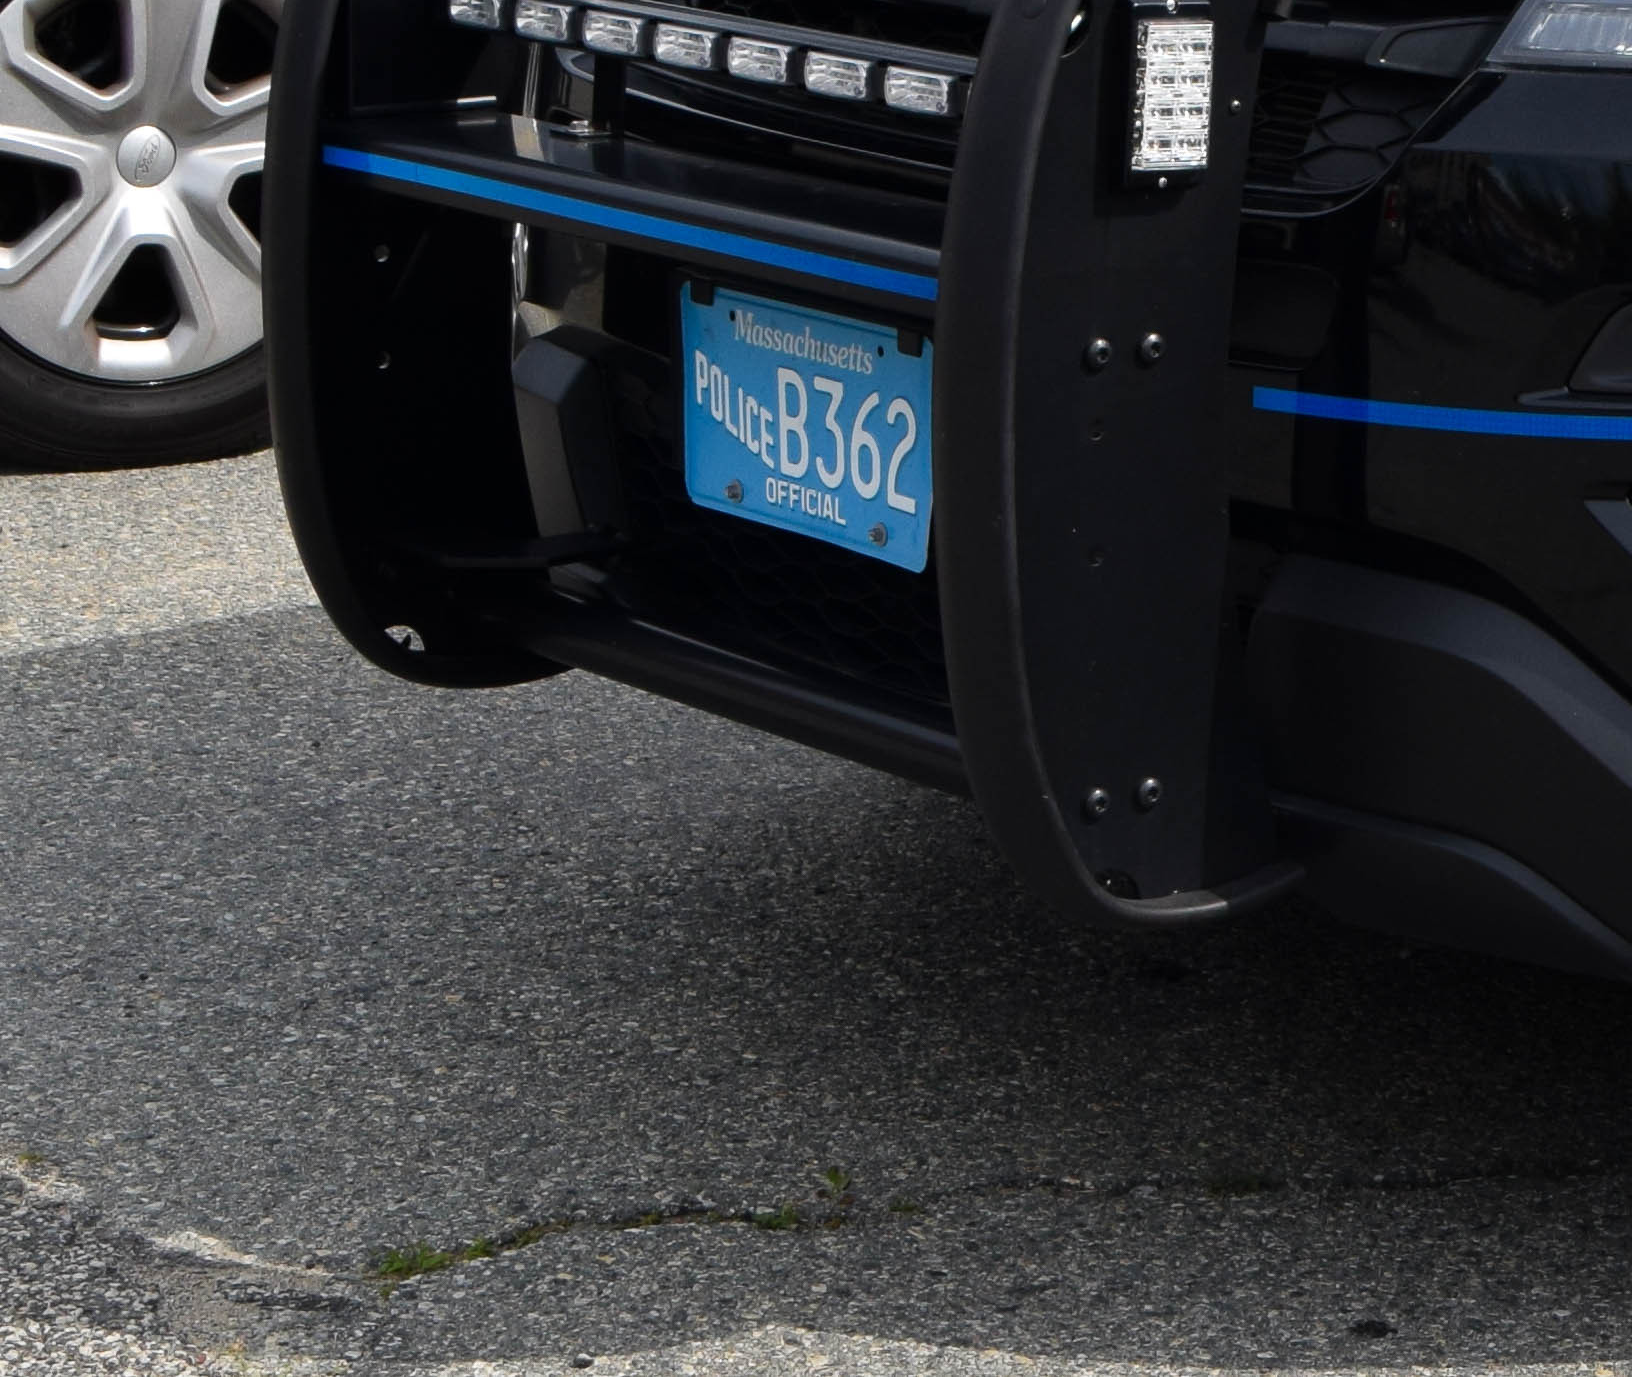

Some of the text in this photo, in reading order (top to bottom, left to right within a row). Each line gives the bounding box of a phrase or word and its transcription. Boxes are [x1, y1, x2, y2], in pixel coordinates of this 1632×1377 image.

[733, 309, 873, 374] Massachusetts
[695, 350, 917, 515] POLICE B362
[765, 477, 847, 525] OFFICIAL
